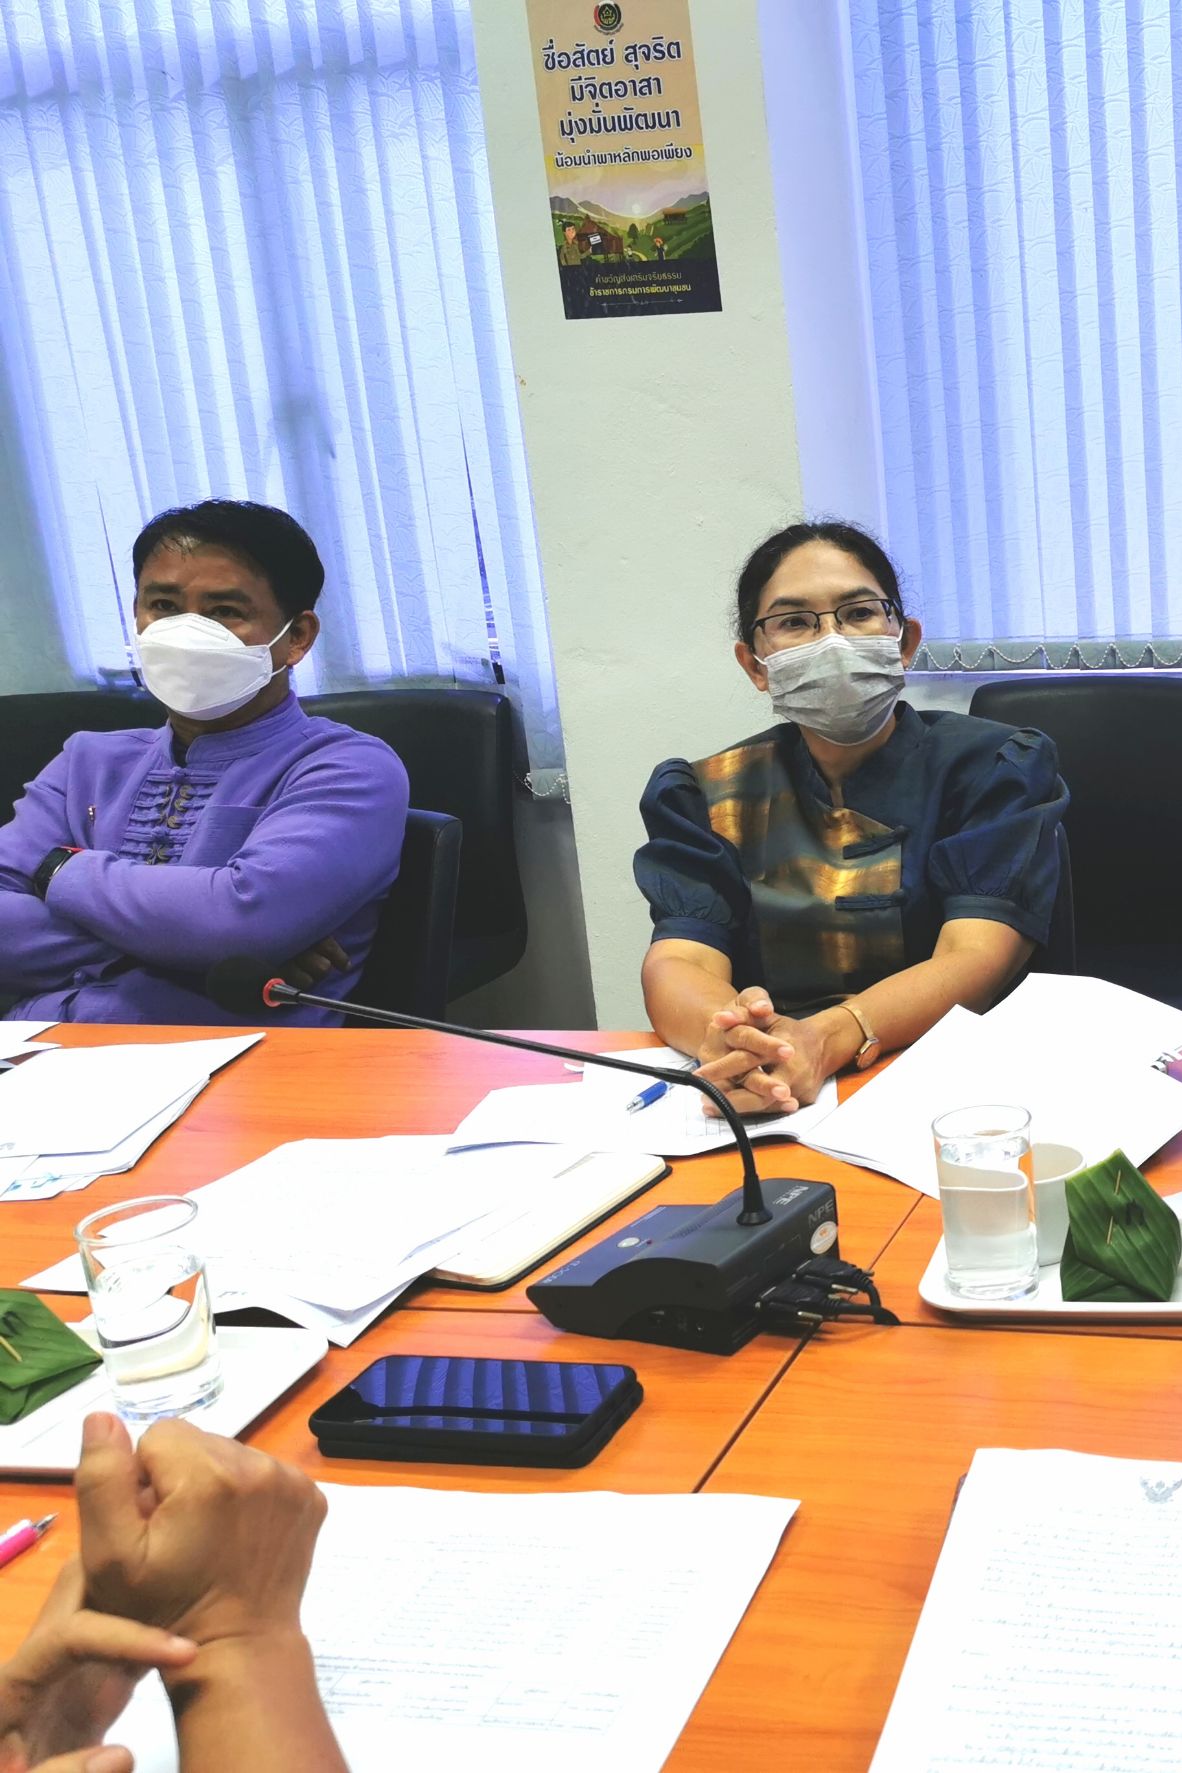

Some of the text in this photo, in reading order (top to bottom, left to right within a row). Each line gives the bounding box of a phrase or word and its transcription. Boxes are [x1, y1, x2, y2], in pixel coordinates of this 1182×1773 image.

[542, 37, 682, 70] ซื่อสัตย์ สุจริต
[570, 75, 662, 102] มีจิตอาสา
[559, 103, 681, 143] มุ่งมั่นพัฒนา
[555, 145, 692, 168] น้อมนำพาหลักพอเพียง
[808, 1199, 834, 1228] NPE
